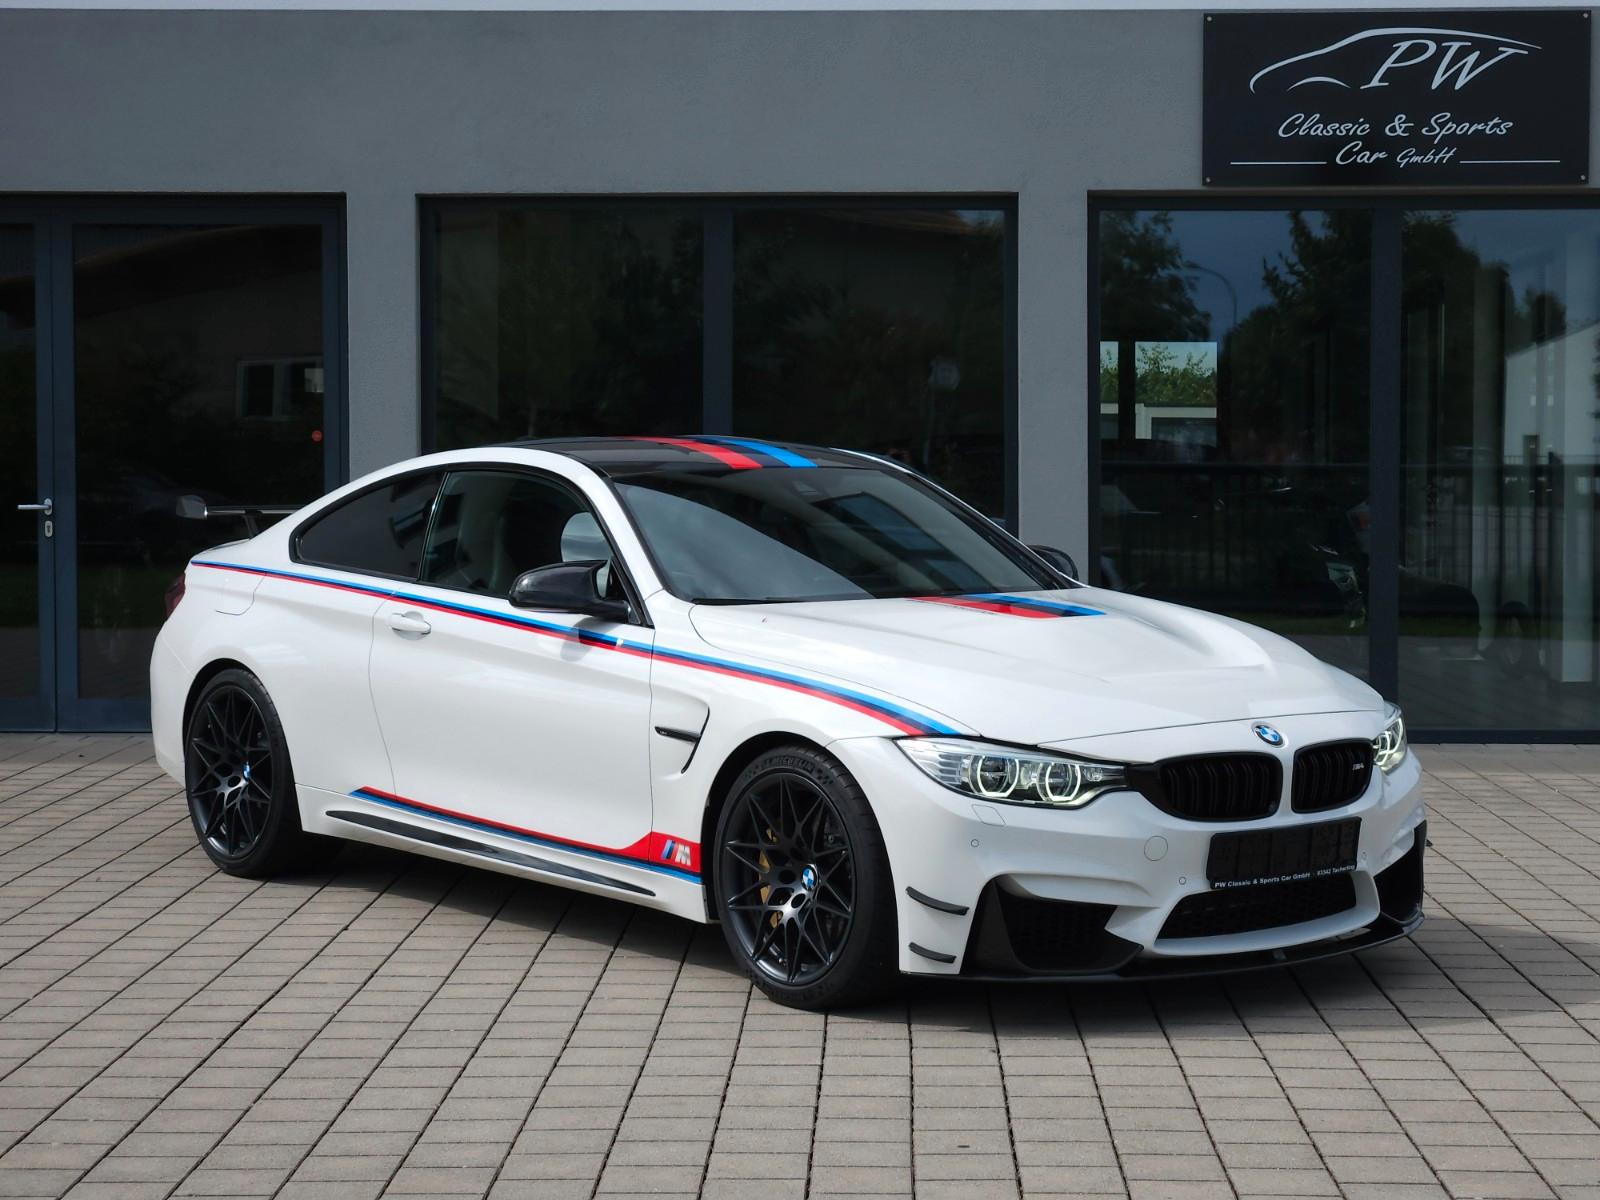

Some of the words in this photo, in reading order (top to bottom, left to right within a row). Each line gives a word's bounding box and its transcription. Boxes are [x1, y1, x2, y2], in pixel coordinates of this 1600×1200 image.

[1359, 39, 1528, 90] PW
[1278, 113, 1371, 138] Classic
[1384, 114, 1414, 137] &
[1421, 112, 1514, 144] Sports
[1335, 141, 1388, 166] Car
[1396, 147, 1457, 168] GmbH
[1214, 881, 1227, 889] PW
[1227, 879, 1251, 888] Classic
[1259, 876, 1280, 885] Sports
[1281, 874, 1292, 882] Car
[1292, 872, 1311, 880] GmbH
